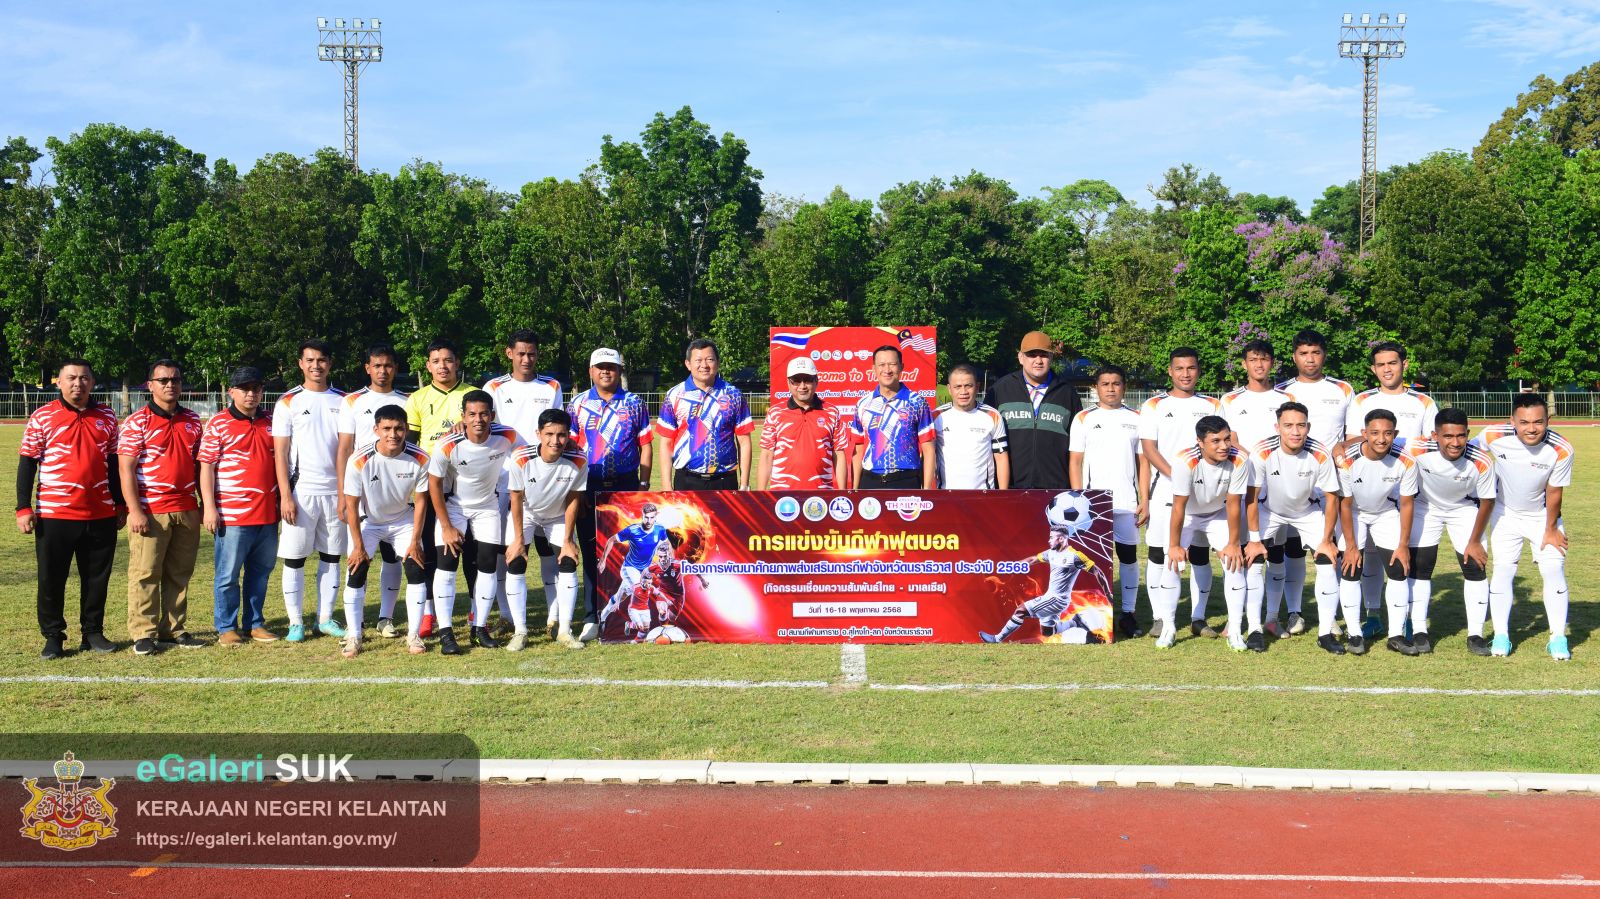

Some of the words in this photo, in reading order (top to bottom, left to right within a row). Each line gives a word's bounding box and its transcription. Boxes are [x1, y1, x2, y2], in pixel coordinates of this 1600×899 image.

[849, 367, 863, 382] to
[749, 529, 960, 556] การแข่งขันกีฬาฟุตบอล
[956, 561, 993, 573] ประจำปี
[998, 562, 1029, 573] 2568
[908, 582, 947, 593] มาเลเซีย)
[808, 605, 822, 614] วันที่
